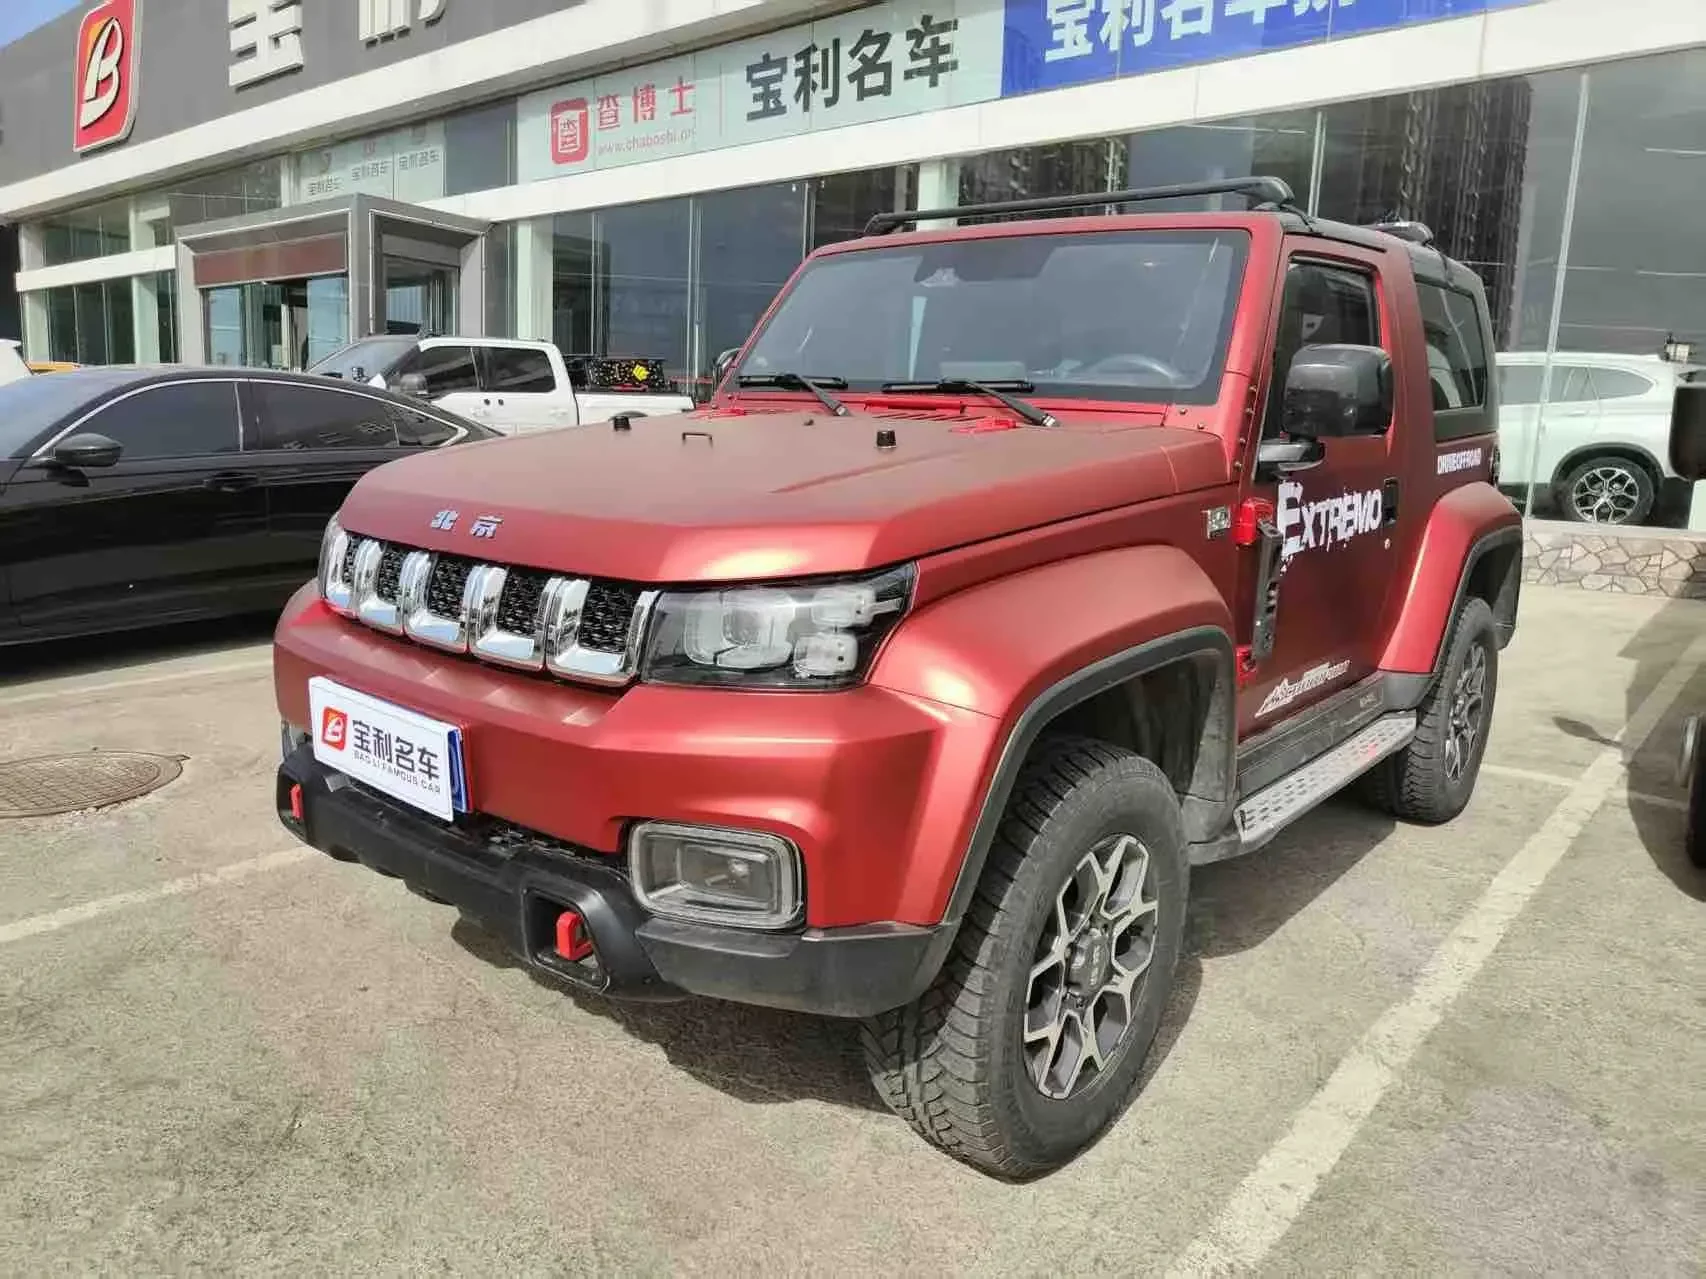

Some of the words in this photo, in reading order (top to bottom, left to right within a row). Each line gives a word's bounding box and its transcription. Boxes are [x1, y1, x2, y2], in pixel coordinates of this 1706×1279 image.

[745, 14, 958, 121] 宝利名车
[430, 510, 504, 538] 北京
[352, 719, 440, 781] 宝利名车
